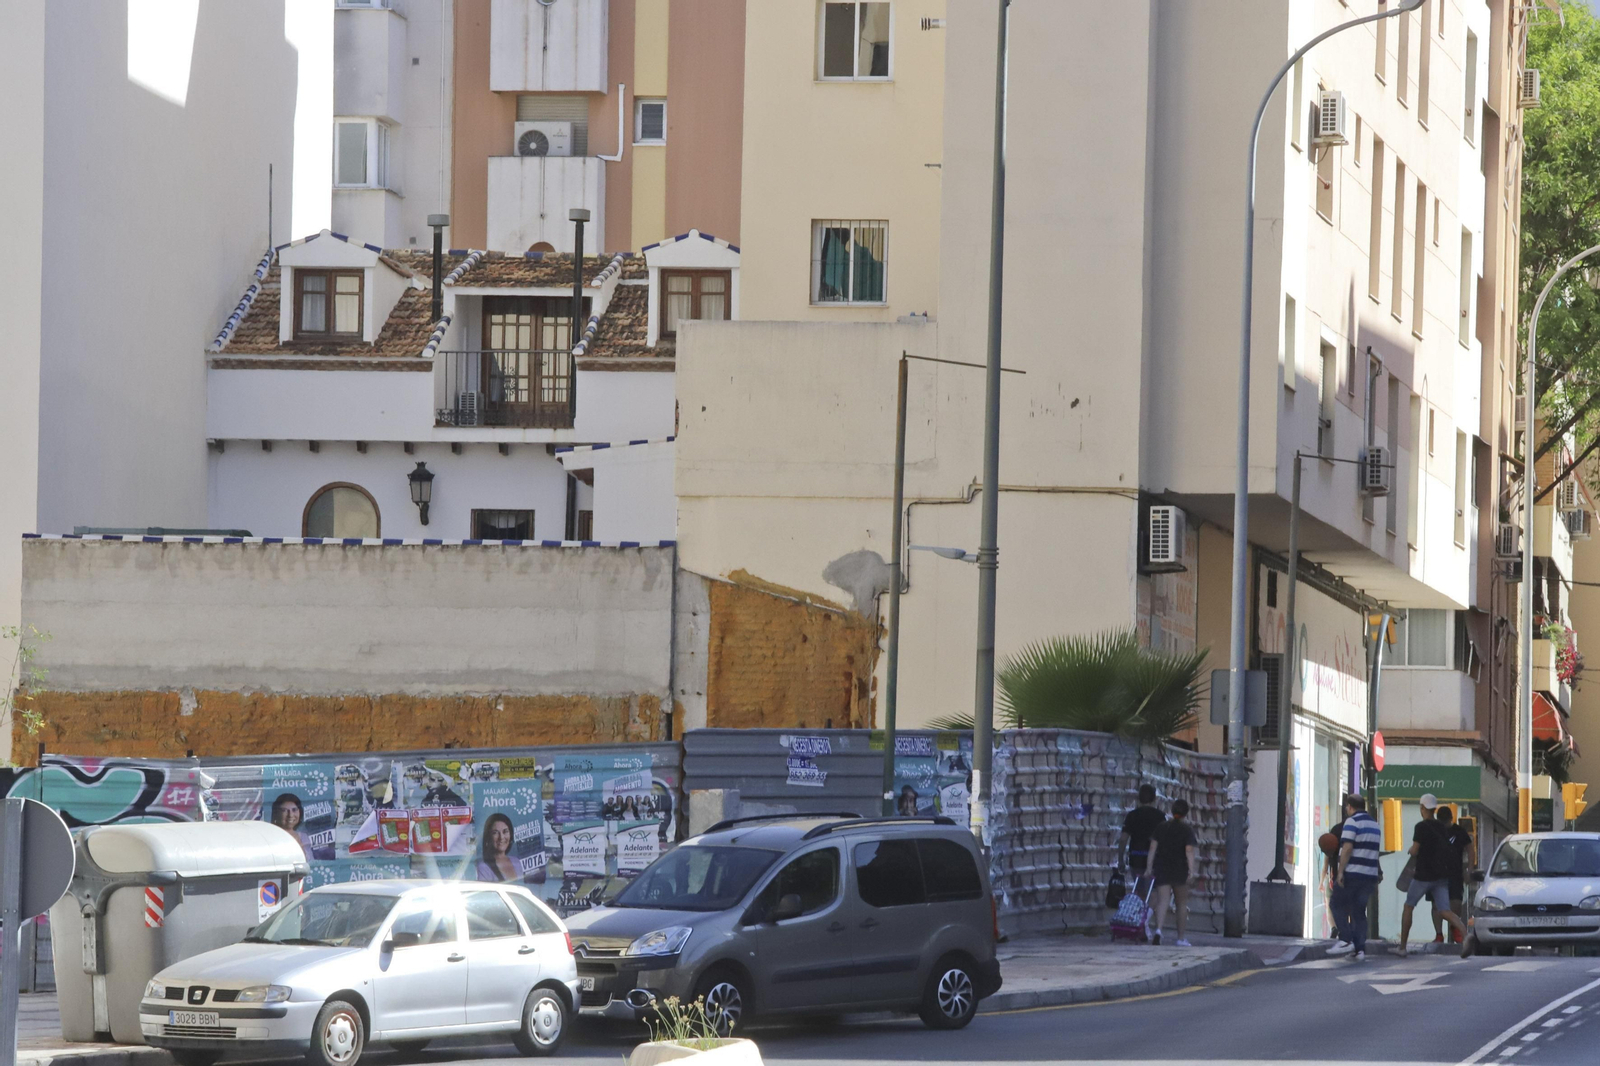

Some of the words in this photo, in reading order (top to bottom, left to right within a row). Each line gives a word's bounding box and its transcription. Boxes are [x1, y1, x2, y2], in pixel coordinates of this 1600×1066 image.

[565, 762, 583, 770] Ahora
[613, 761, 632, 769] Ahora
[272, 778, 307, 788] Ahora
[1376, 775, 1445, 789] arural.com
[167, 786, 195, 805] 17
[482, 797, 516, 808] Ahora
[310, 831, 334, 846] VOTA
[514, 826, 540, 840] MOMENTO
[570, 846, 599, 854] Adelante
[624, 844, 653, 852] Adelante
[521, 853, 543, 870] VOTA
[349, 871, 384, 881] Ahora
[175, 1013, 197, 1024] 3028
[199, 1013, 216, 1025] BBN
